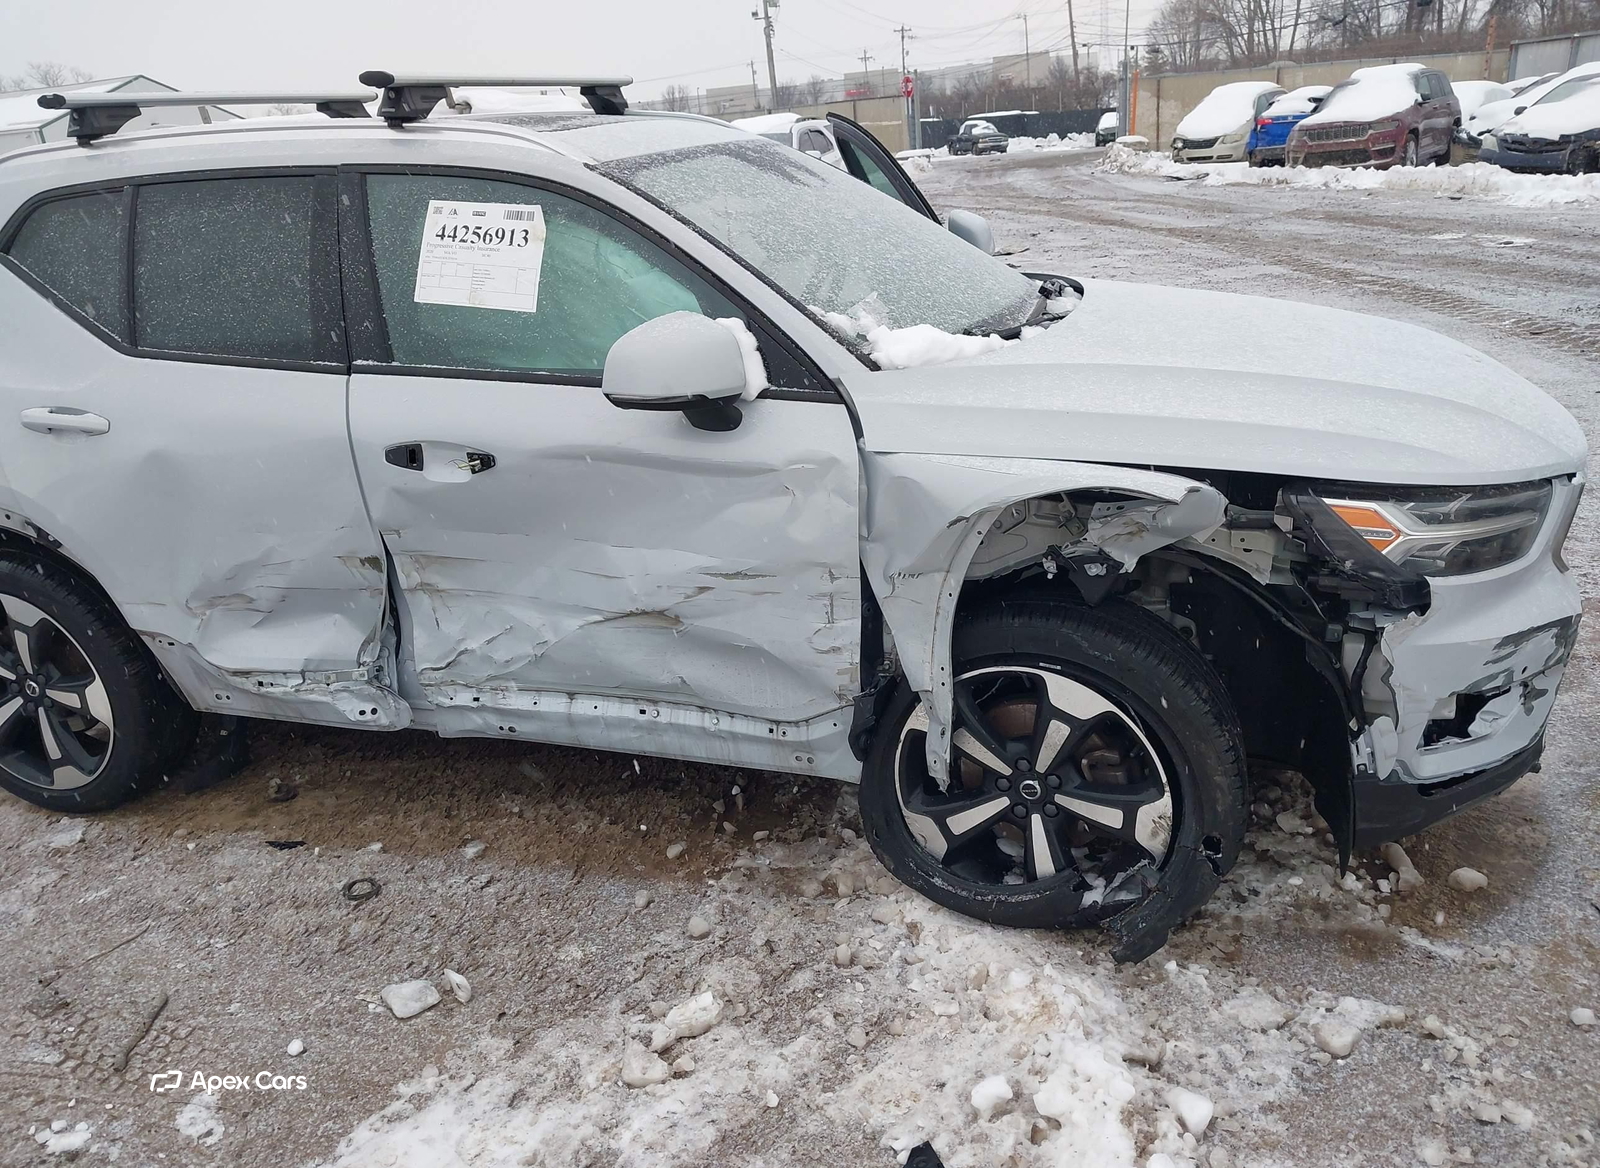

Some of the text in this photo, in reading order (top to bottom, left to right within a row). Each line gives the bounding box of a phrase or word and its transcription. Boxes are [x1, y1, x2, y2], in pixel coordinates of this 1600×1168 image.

[435, 223, 530, 248] 44256913
[426, 242, 454, 250] Progressive
[455, 243, 475, 252] Casualty
